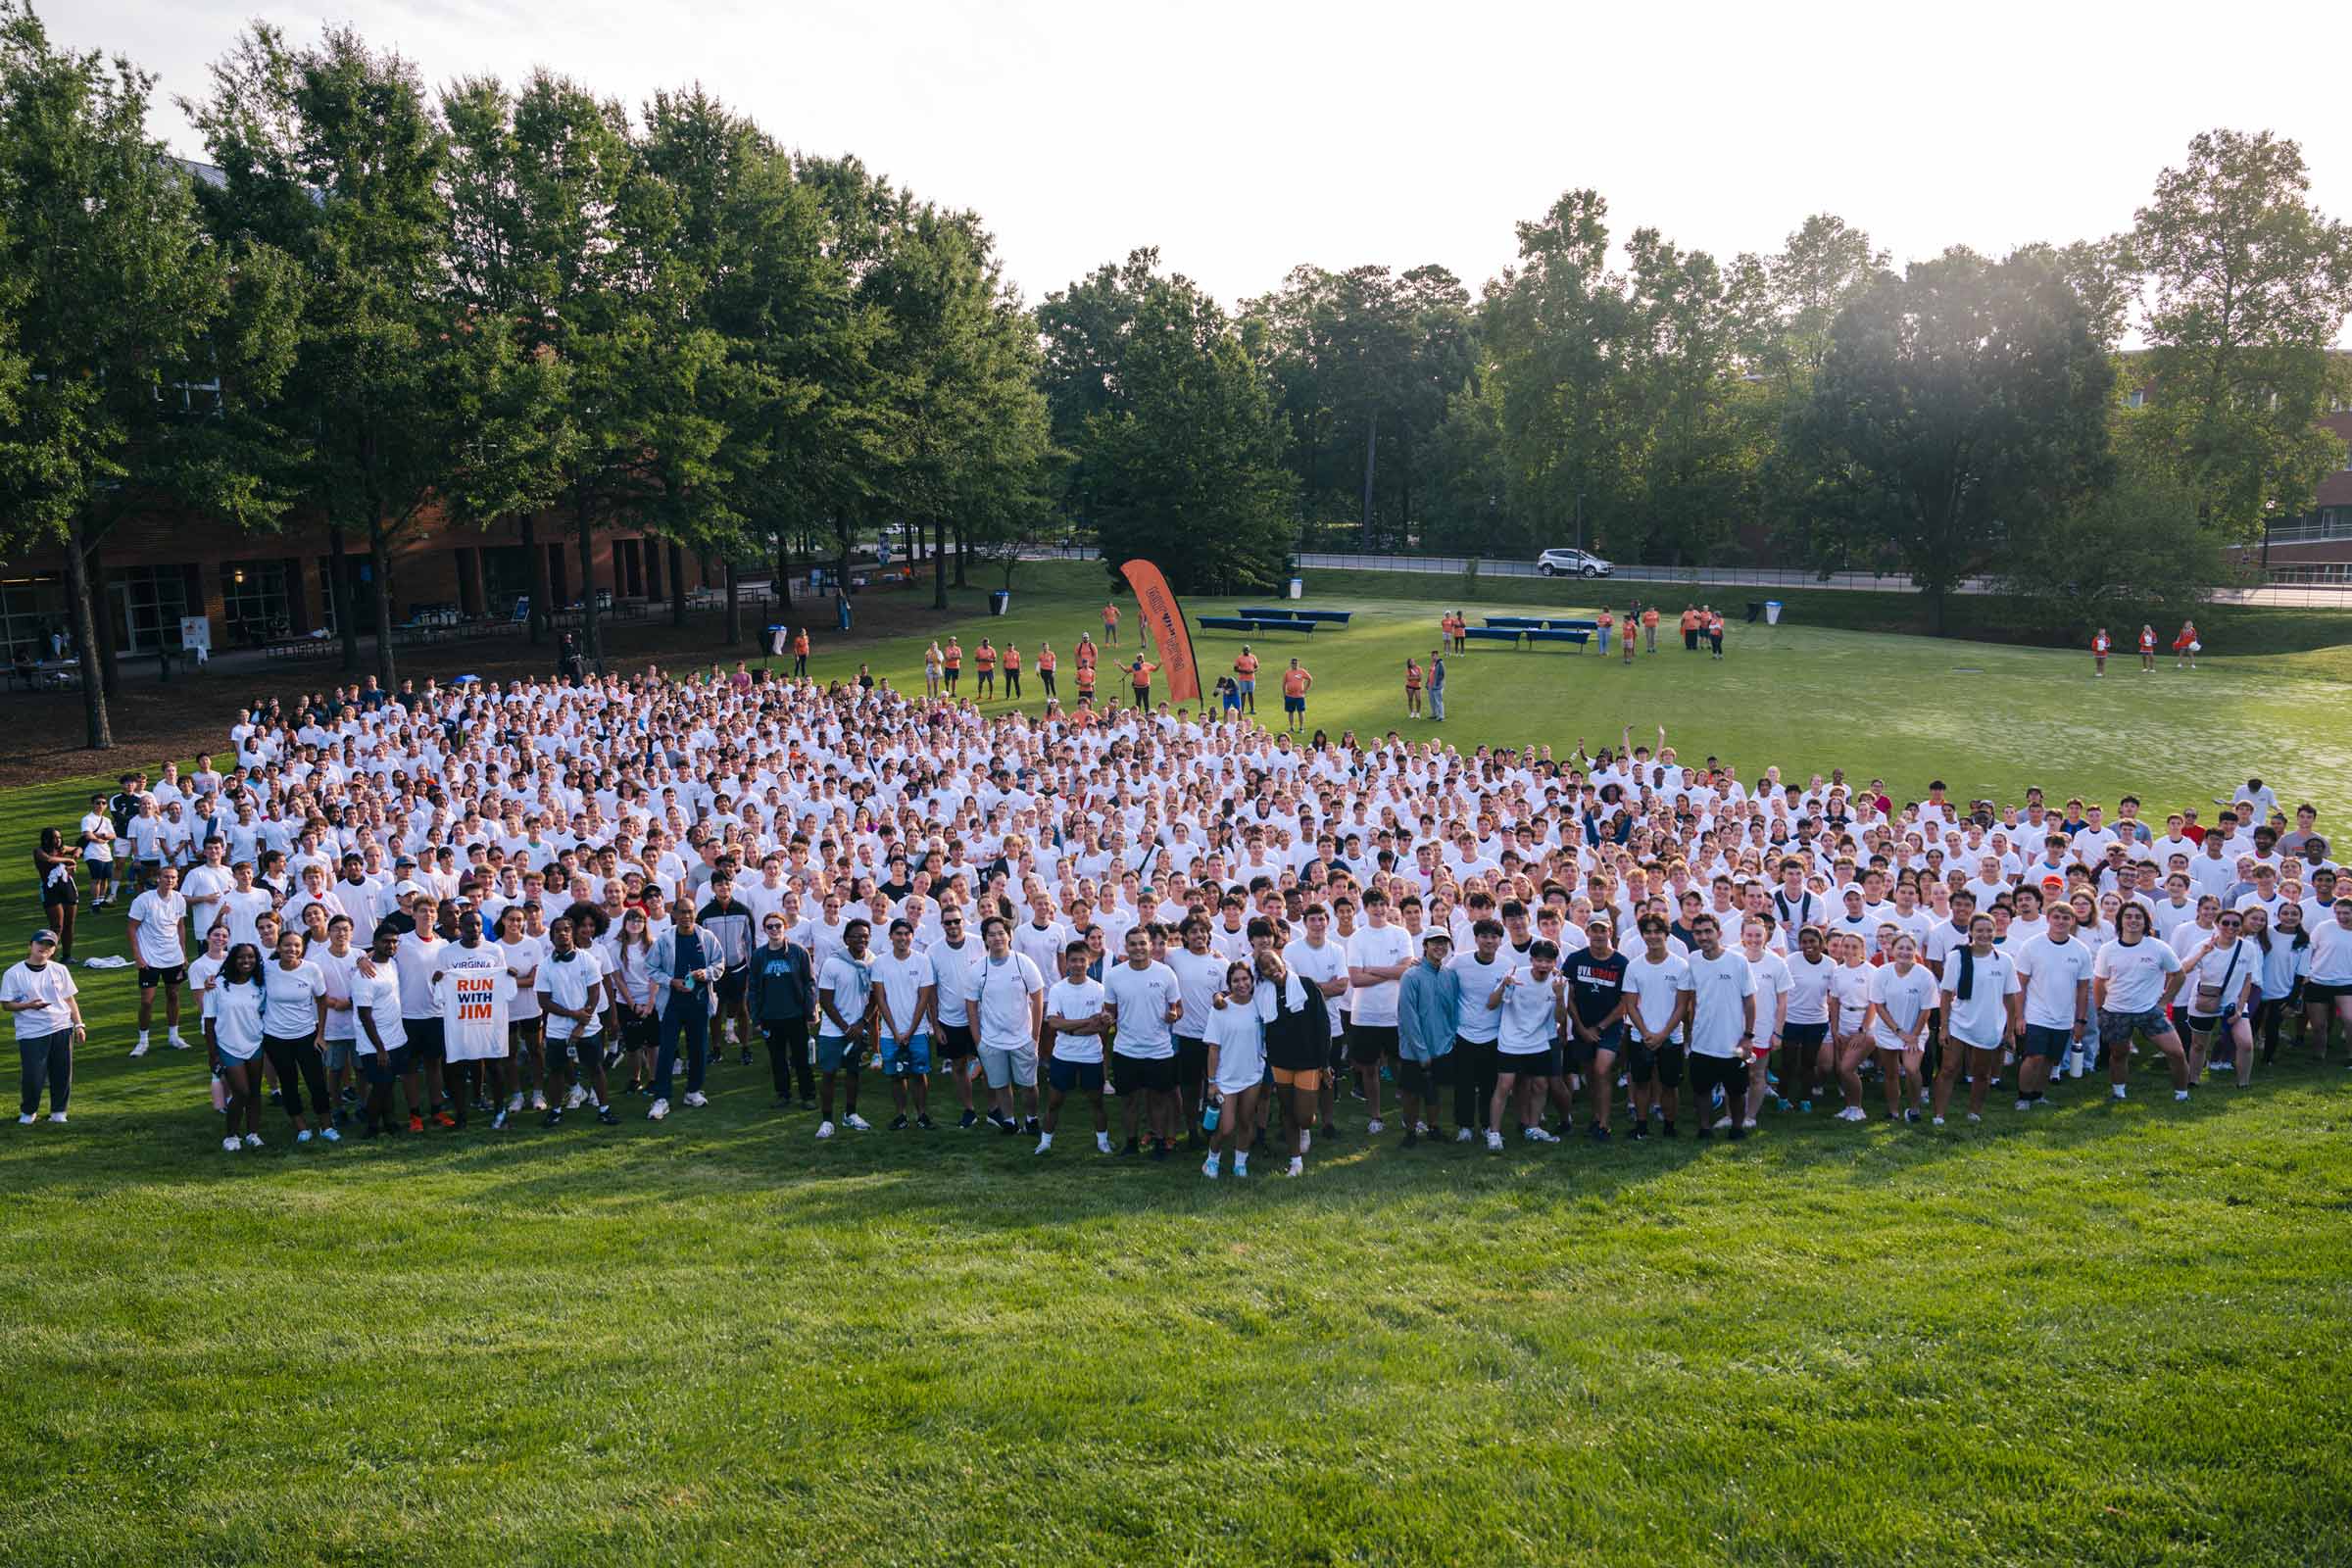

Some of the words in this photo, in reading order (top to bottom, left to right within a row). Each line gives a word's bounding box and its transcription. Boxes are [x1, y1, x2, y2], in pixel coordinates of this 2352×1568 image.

[457, 979, 493, 991] RUN
[458, 993, 492, 1003] WITH
[458, 1004, 492, 1019] JIM
